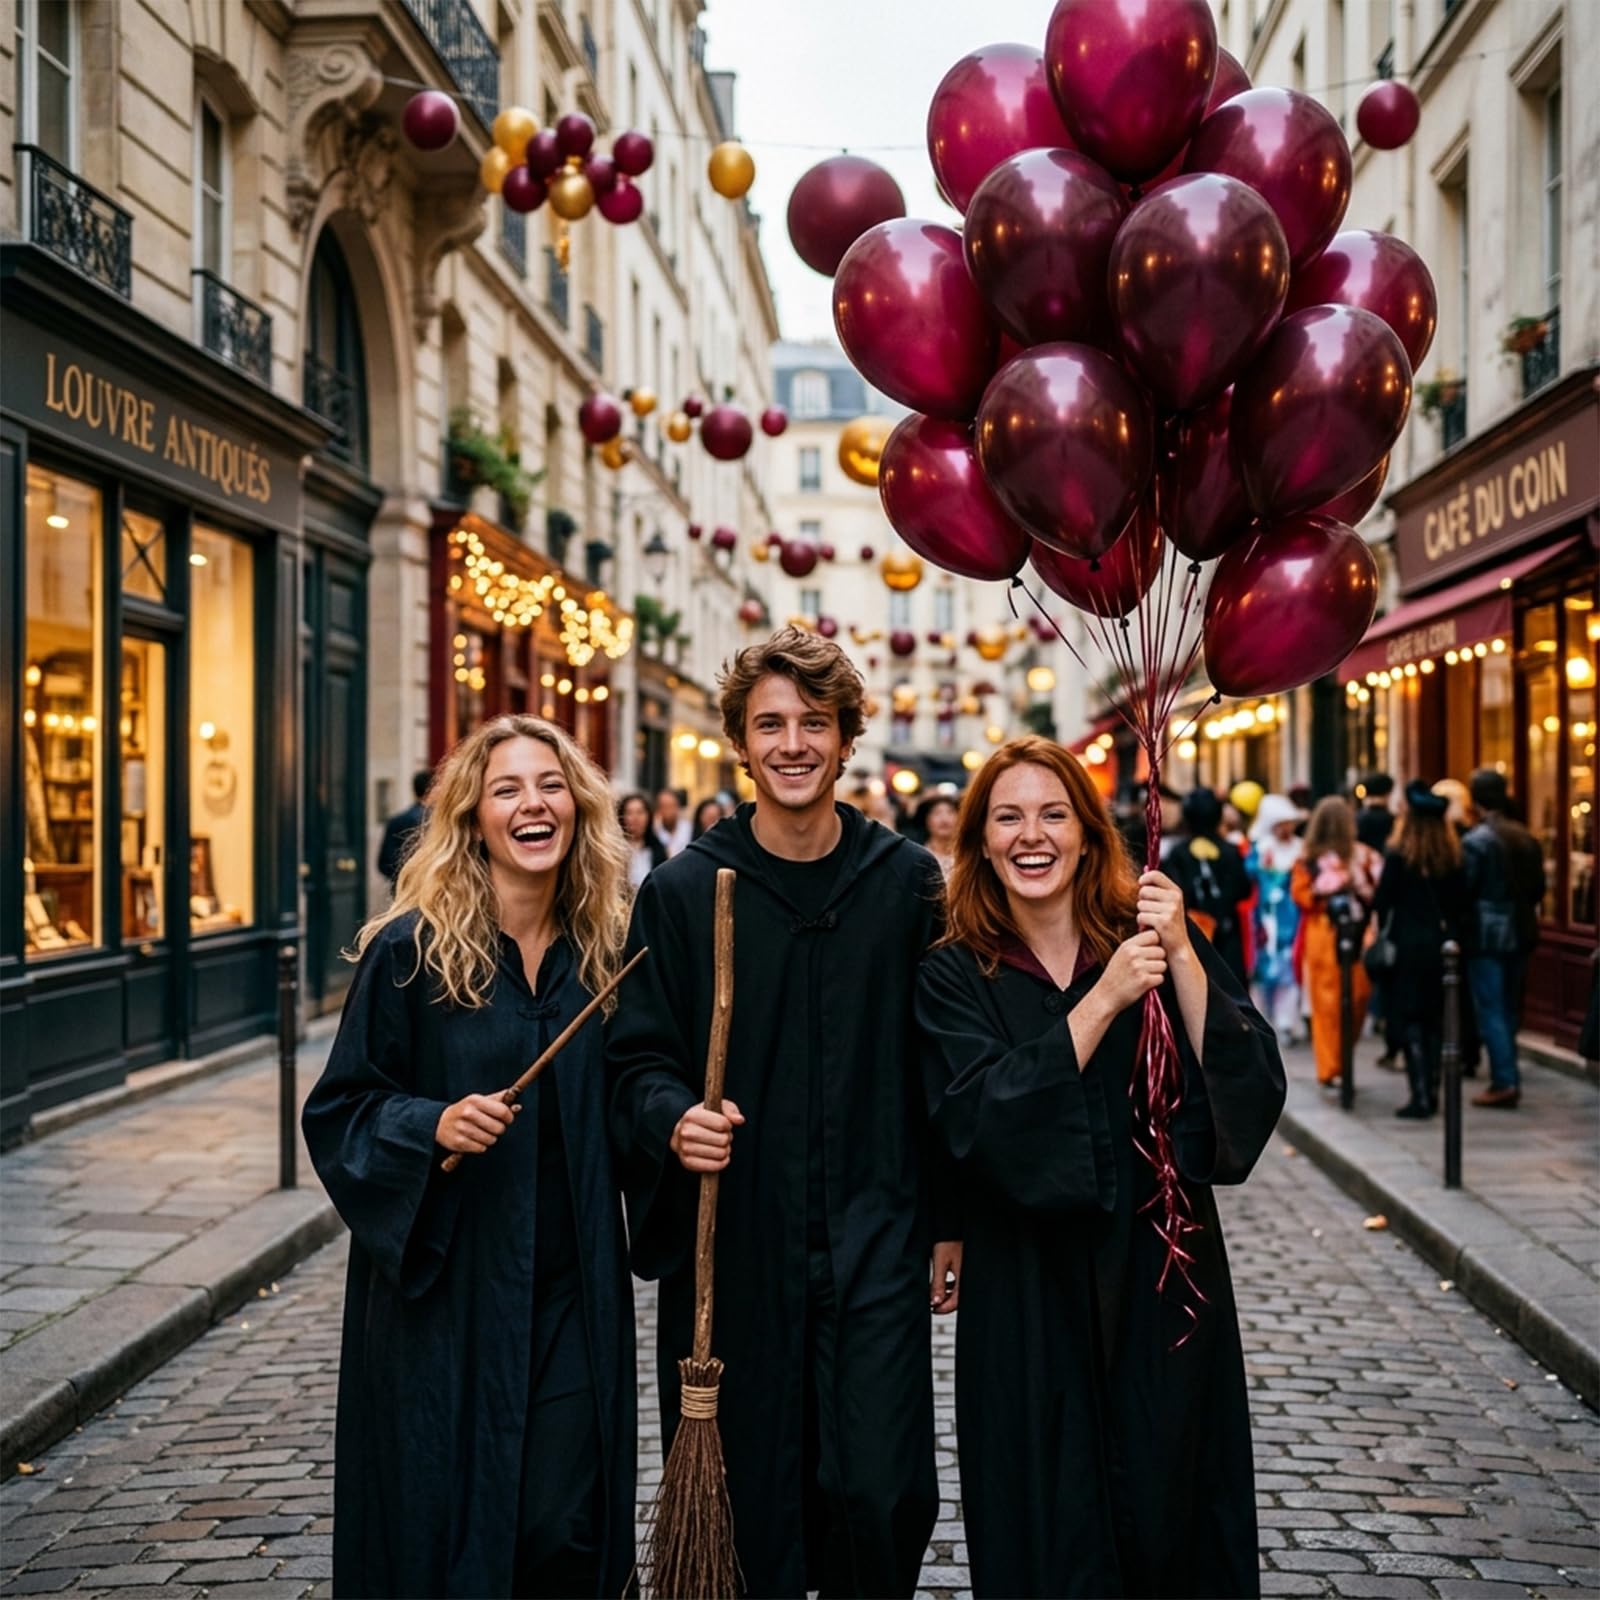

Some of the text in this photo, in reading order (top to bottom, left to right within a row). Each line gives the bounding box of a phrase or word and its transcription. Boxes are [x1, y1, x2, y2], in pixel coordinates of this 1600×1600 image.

[46, 353, 271, 503] LOUVRE ANTIQUÉS
[1424, 440, 1568, 560] CAFÉ DU COIN
